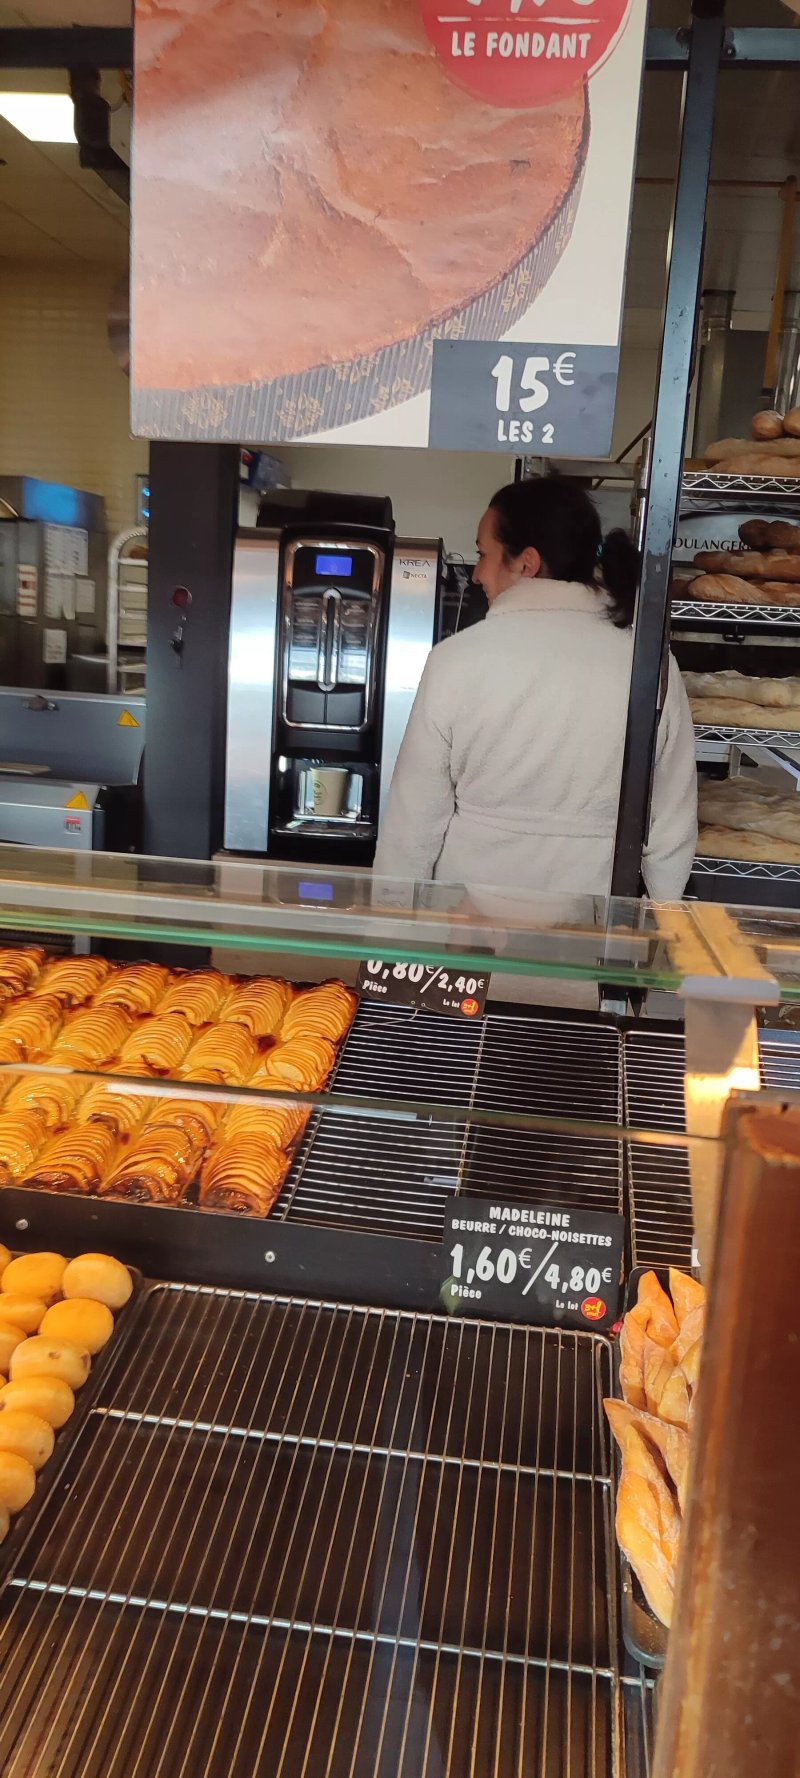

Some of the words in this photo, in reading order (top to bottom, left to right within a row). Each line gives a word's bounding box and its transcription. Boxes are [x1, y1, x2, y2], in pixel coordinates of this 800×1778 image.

[451, 31, 476, 57] LE
[486, 32, 591, 59] FONDANT
[491, 351, 577, 412] 15€
[497, 419, 533, 443] LES
[541, 423, 555, 444] 2
[674, 537, 751, 551] OULANGER
[399, 559, 431, 567] KREA
[489, 1206, 571, 1228] MADELEINE
[451, 1218, 497, 1234] BEURRE
[508, 1225, 612, 1247] CHOCO-NOISETTES
[450, 1284, 482, 1299] Pièce
[567, 1300, 579, 1310] lot
